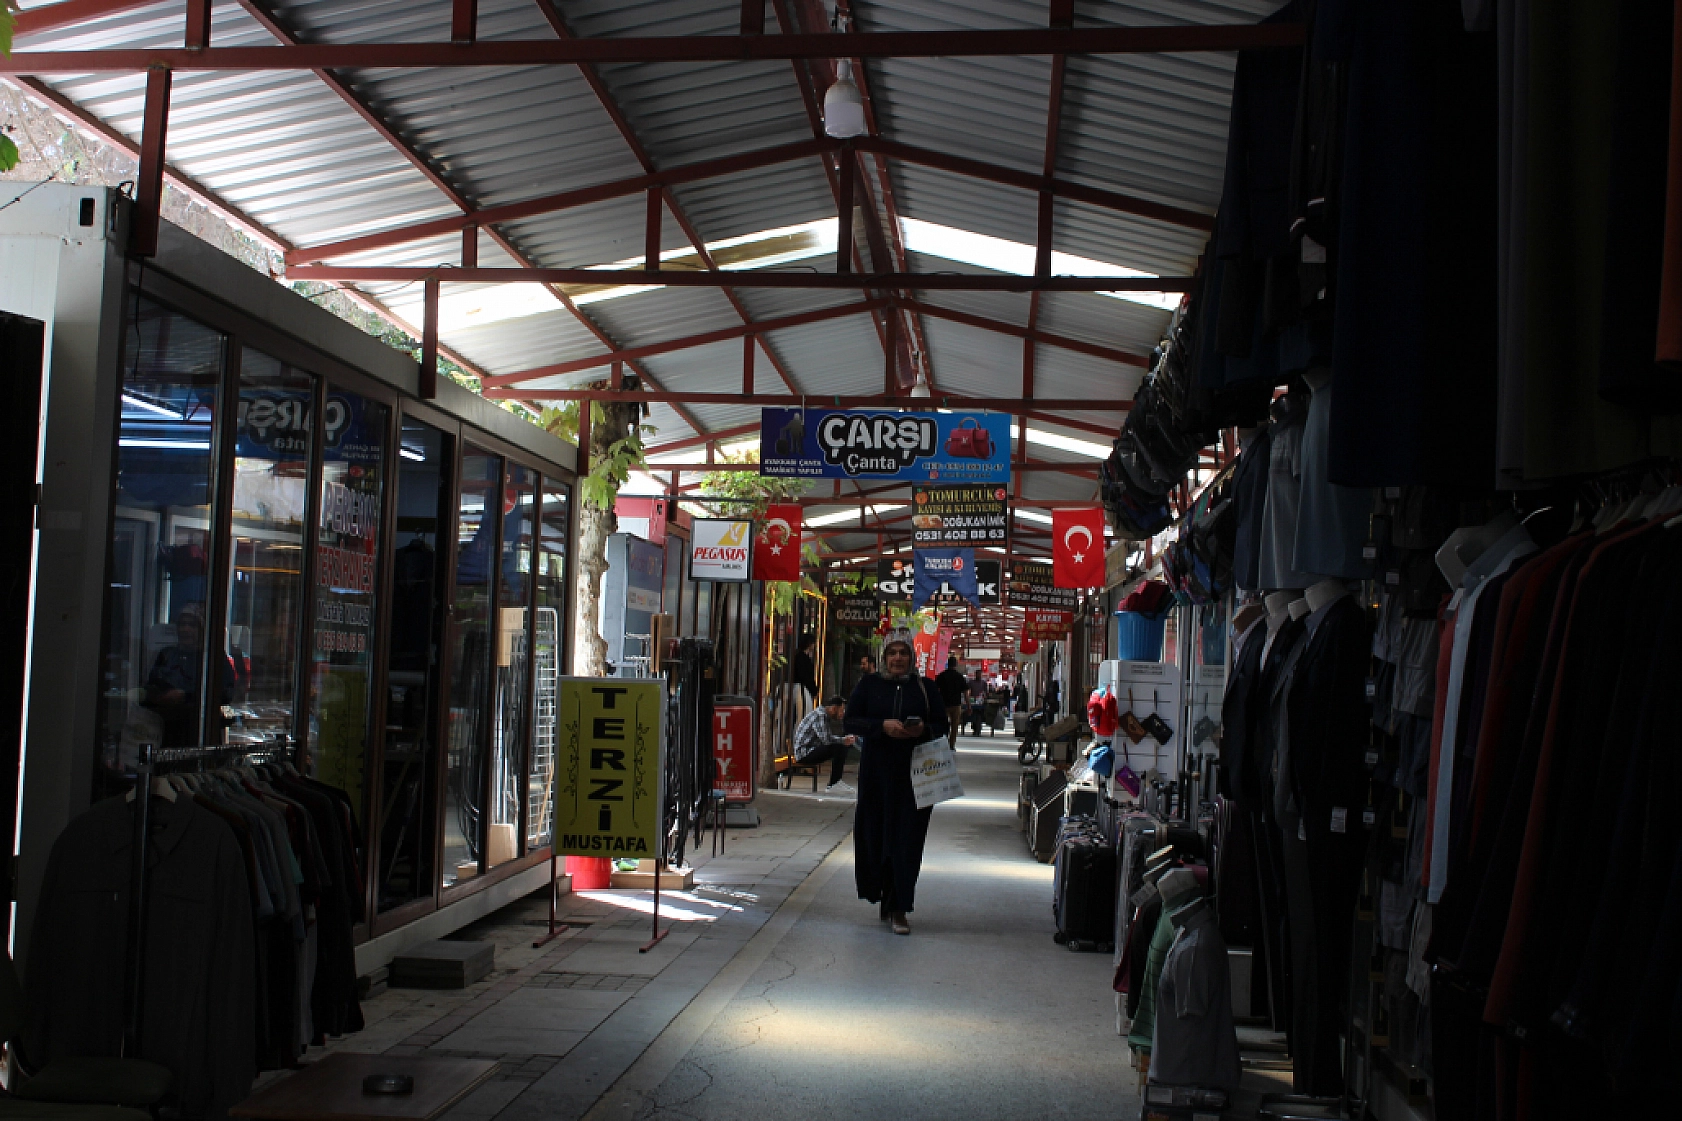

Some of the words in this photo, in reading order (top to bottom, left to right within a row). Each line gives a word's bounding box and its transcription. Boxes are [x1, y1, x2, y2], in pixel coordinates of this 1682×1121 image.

[823, 418, 931, 459] ÇARŞI
[846, 453, 897, 473] Çanta
[927, 489, 995, 503] TOMURCUK
[942, 515, 986, 527] DOĞUKAN
[944, 530, 967, 540] 402
[693, 547, 748, 562] PEGASUS
[715, 711, 733, 776] THY
[588, 687, 628, 831] TERZİ
[563, 834, 648, 852] MUSTAFA
